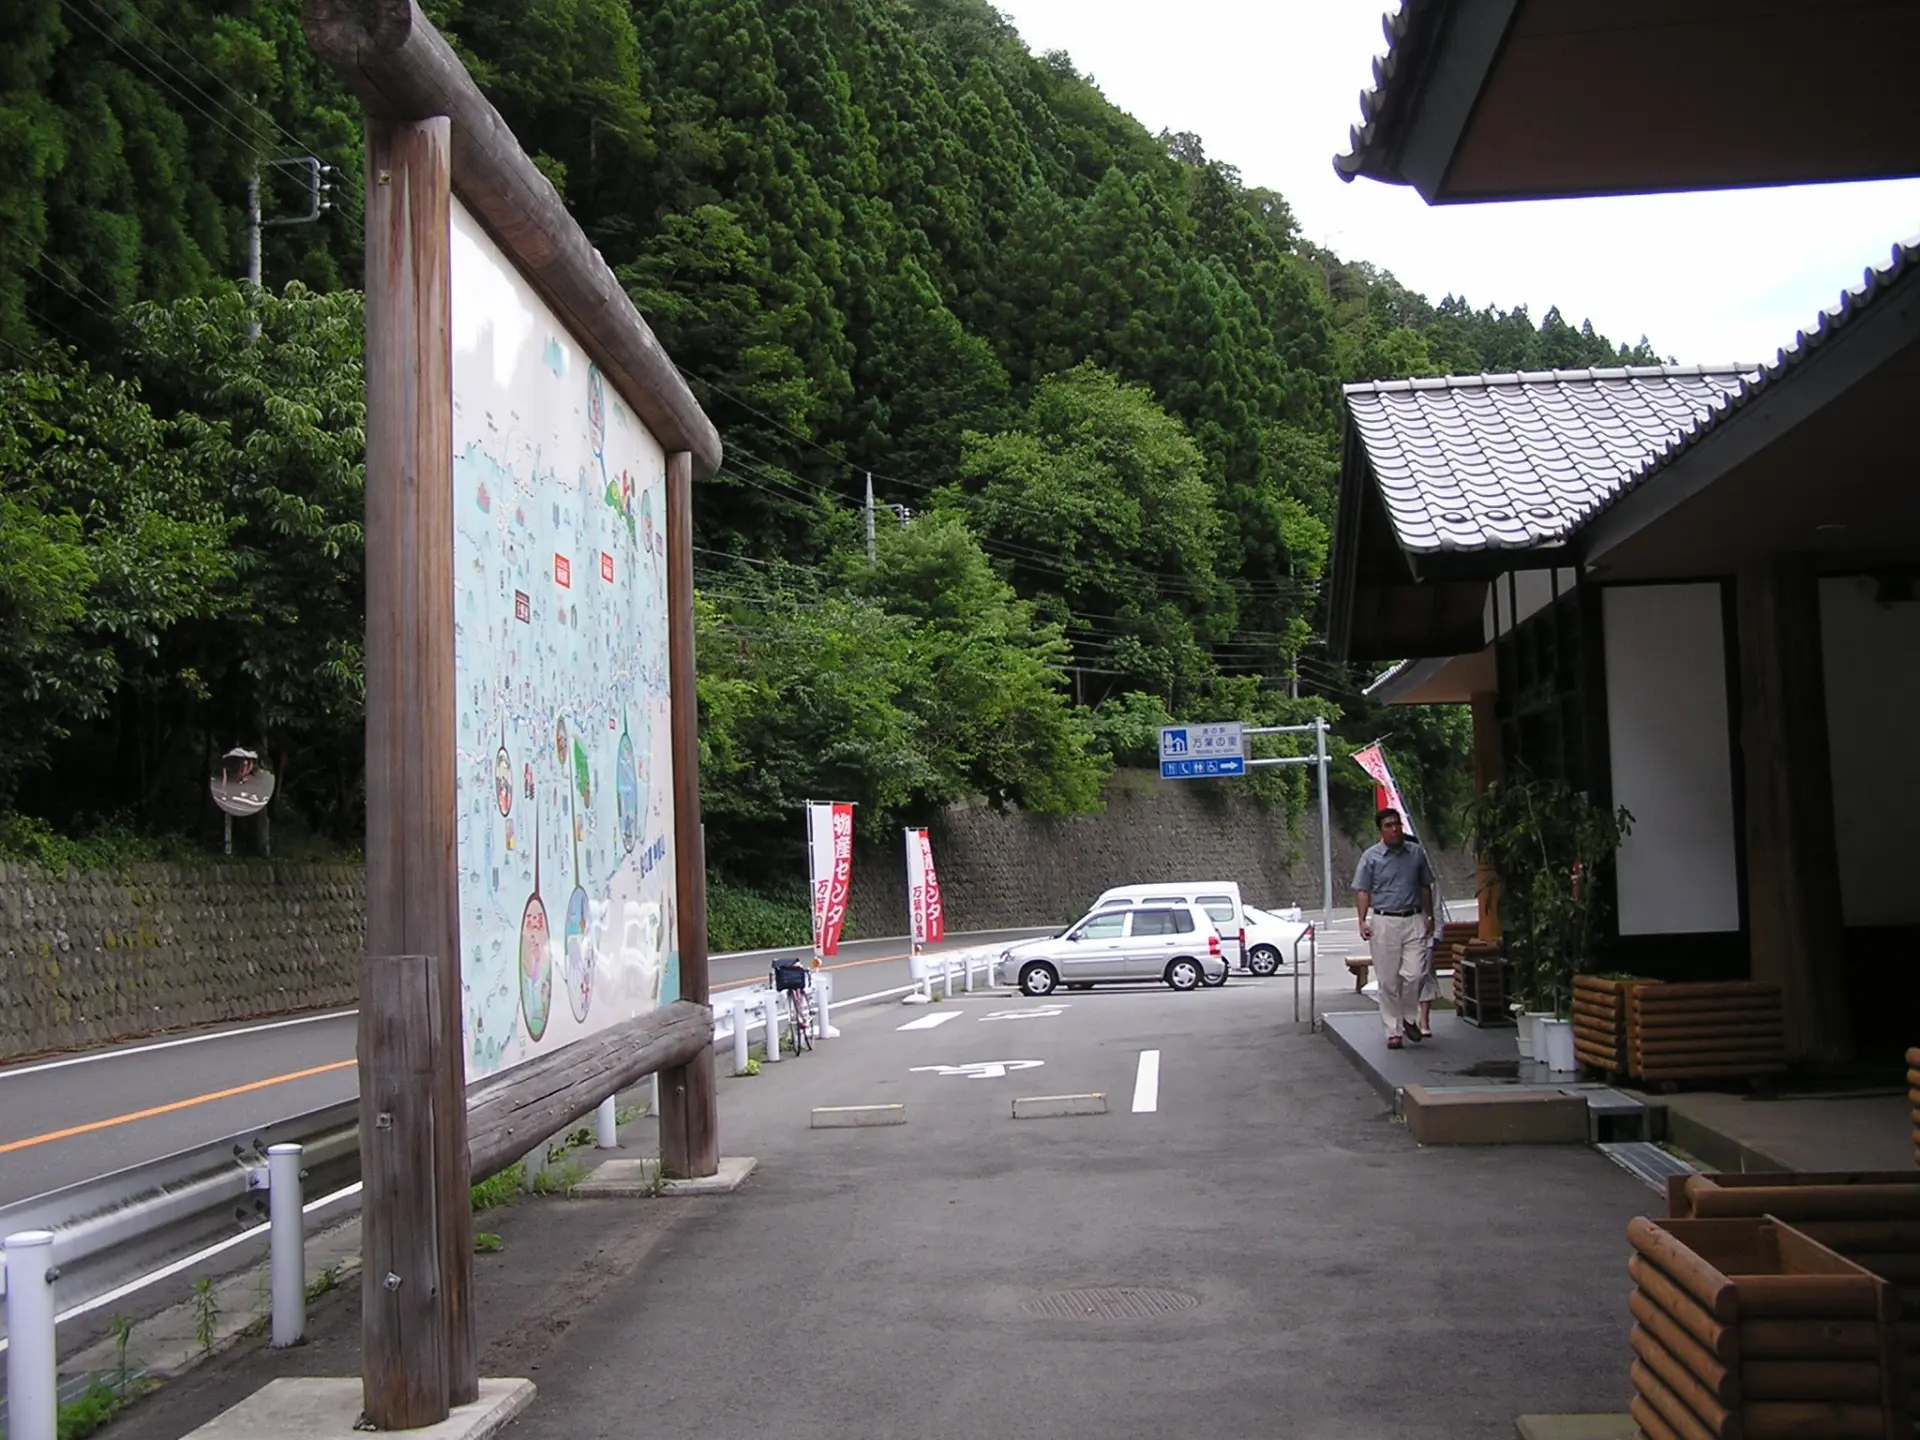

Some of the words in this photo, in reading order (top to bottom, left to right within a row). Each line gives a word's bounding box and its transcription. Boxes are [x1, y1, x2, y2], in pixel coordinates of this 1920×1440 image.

[1192, 736, 1237, 748] 万葉の里
[826, 812, 852, 949] 物産センター
[920, 837, 942, 937] 物産センター
